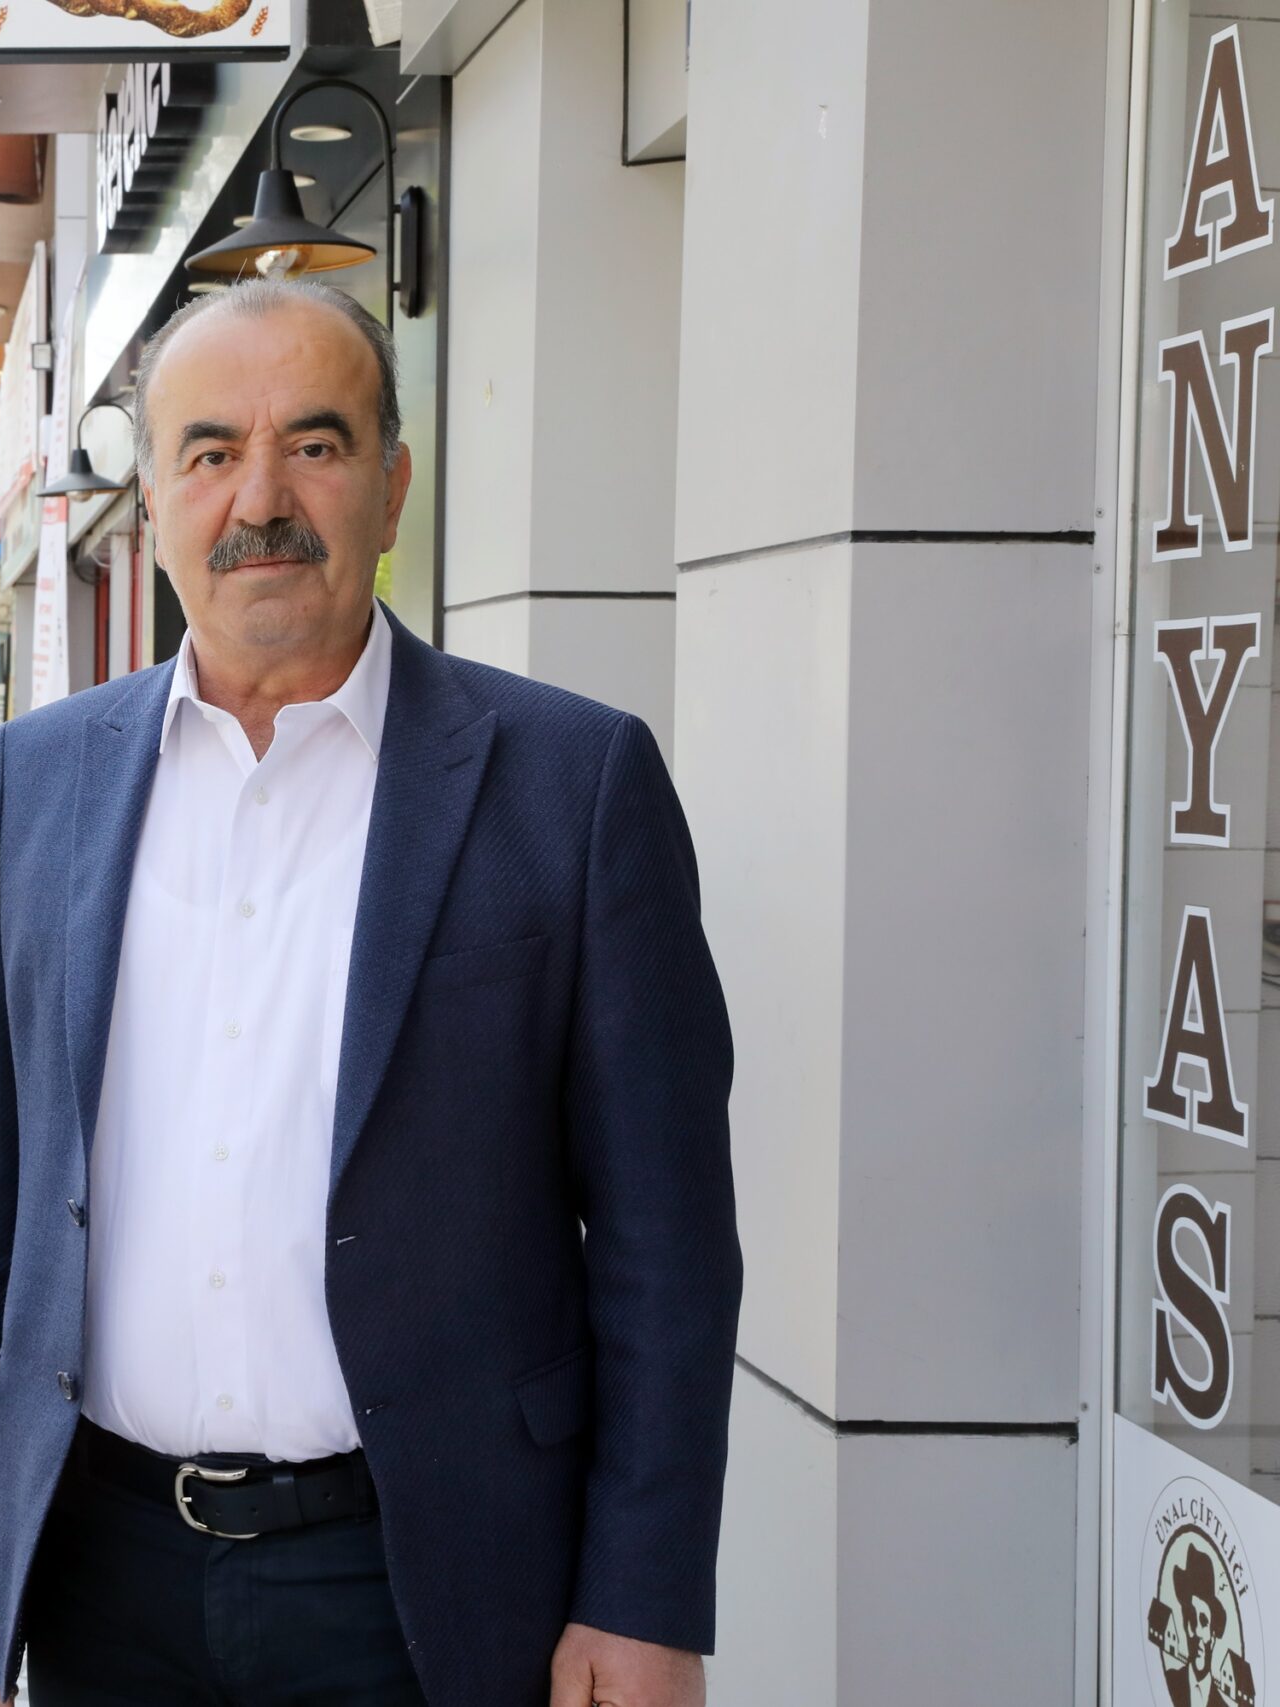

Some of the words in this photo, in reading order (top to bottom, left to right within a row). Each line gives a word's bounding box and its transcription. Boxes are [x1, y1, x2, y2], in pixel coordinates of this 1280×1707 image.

[1143, 0, 1276, 1431] ANYAS
[1154, 1497, 1188, 1546] ÜNAL
[1189, 1496, 1250, 1598] ÇİFTLİĞİ
